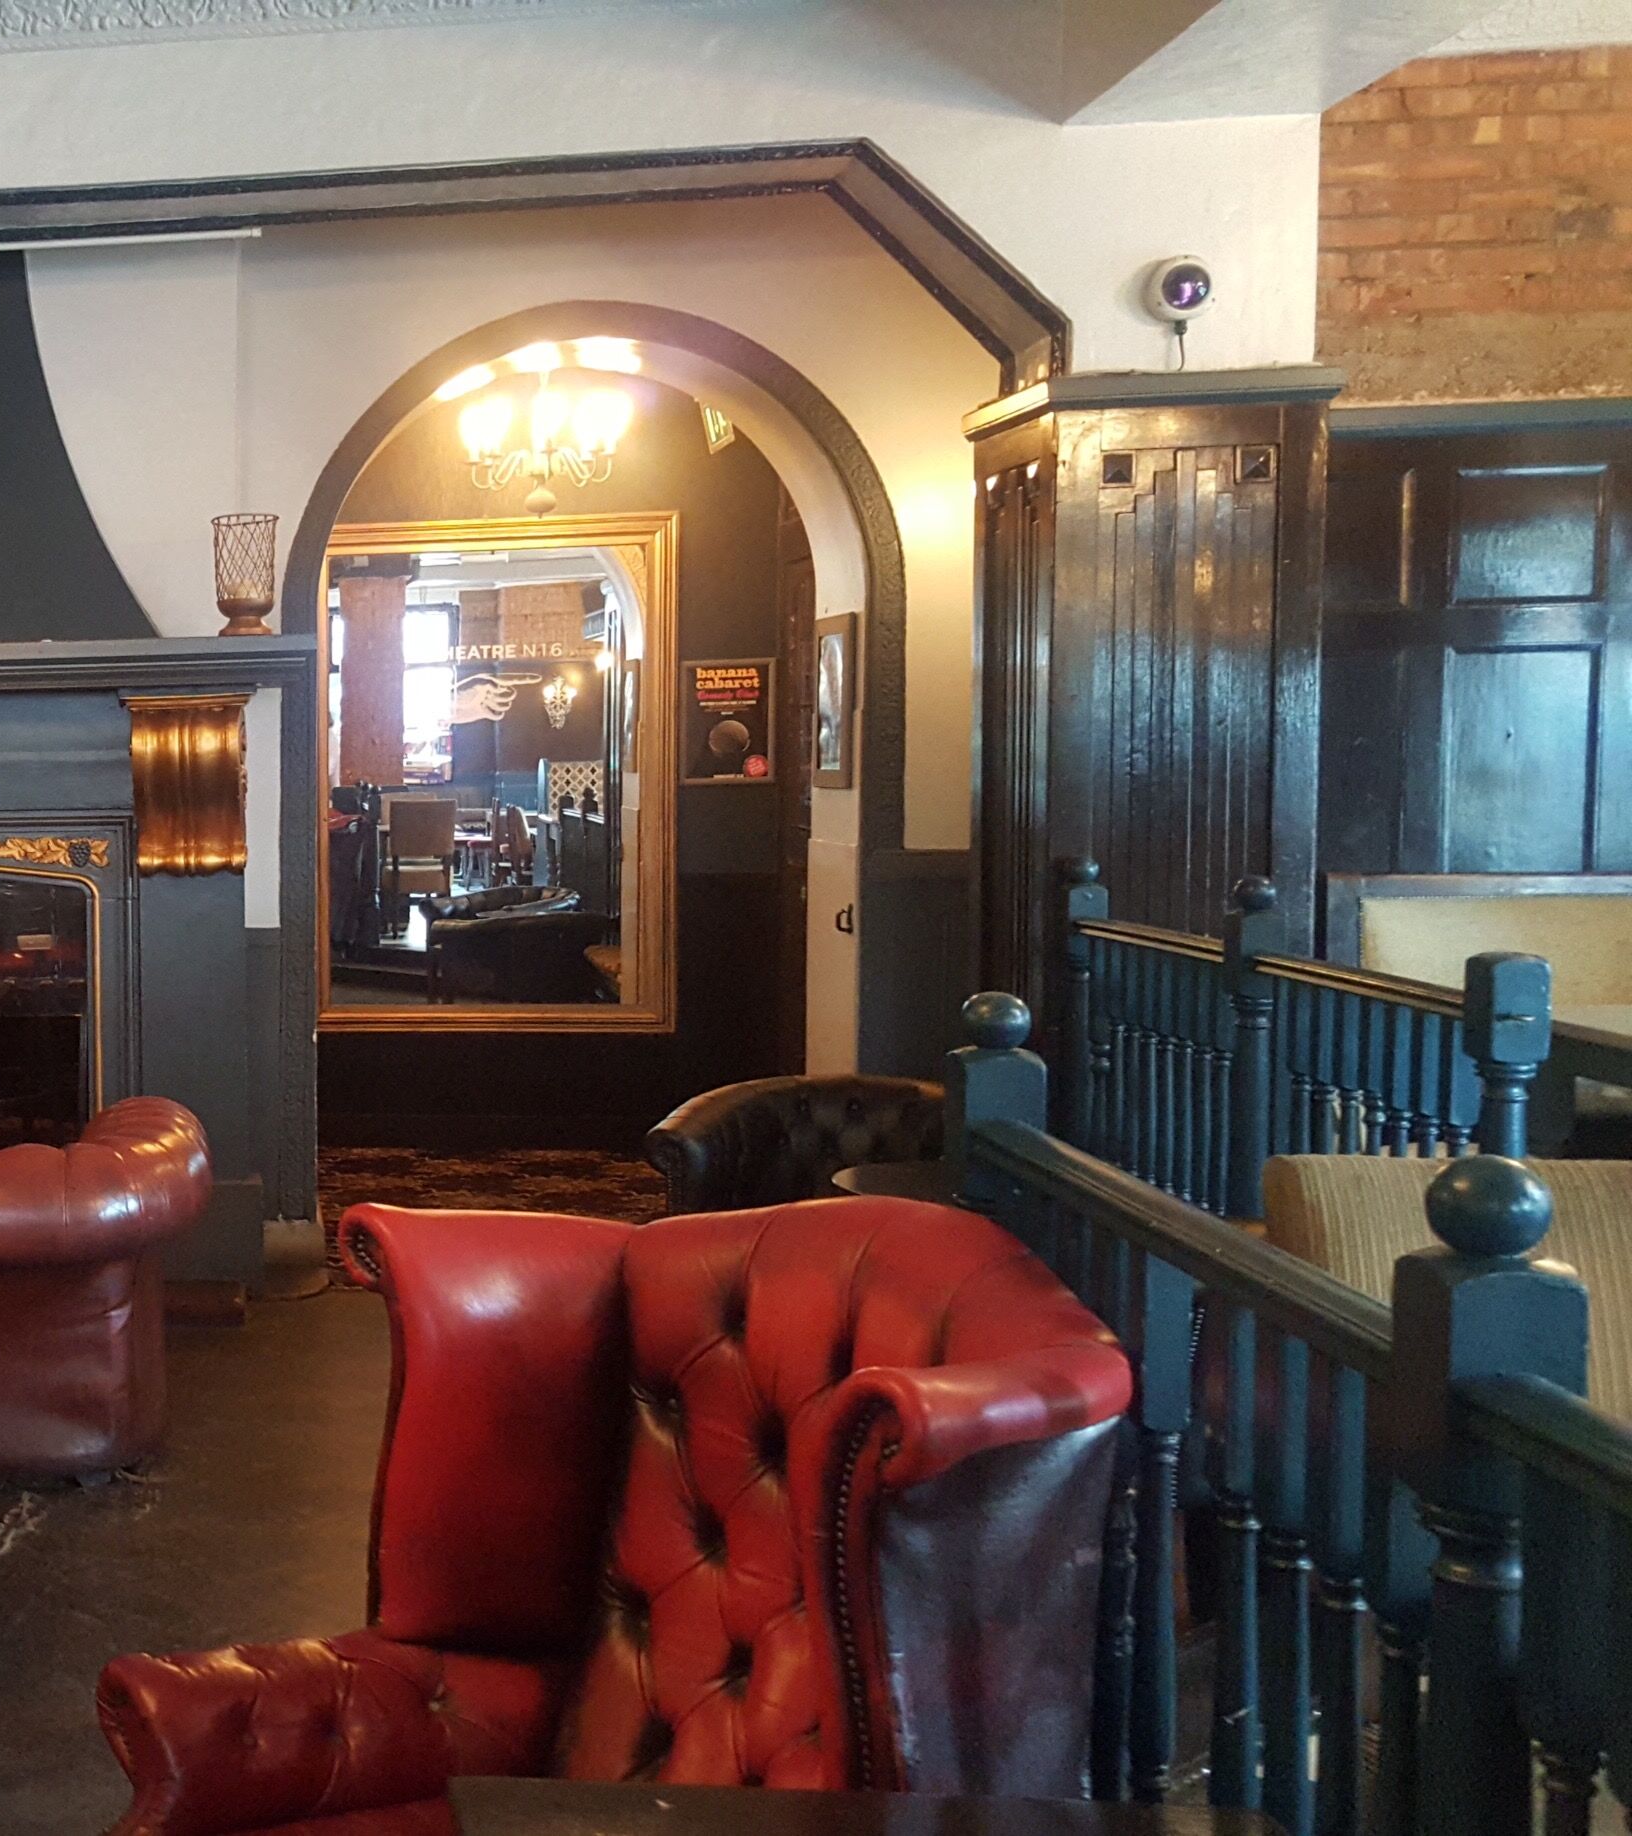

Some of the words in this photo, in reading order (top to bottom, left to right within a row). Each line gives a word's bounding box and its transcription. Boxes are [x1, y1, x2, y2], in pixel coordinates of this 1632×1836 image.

[442, 644, 517, 660] HEATRE
[522, 643, 563, 658] N16
[696, 667, 758, 679] banana
[696, 677, 760, 689] cabaret
